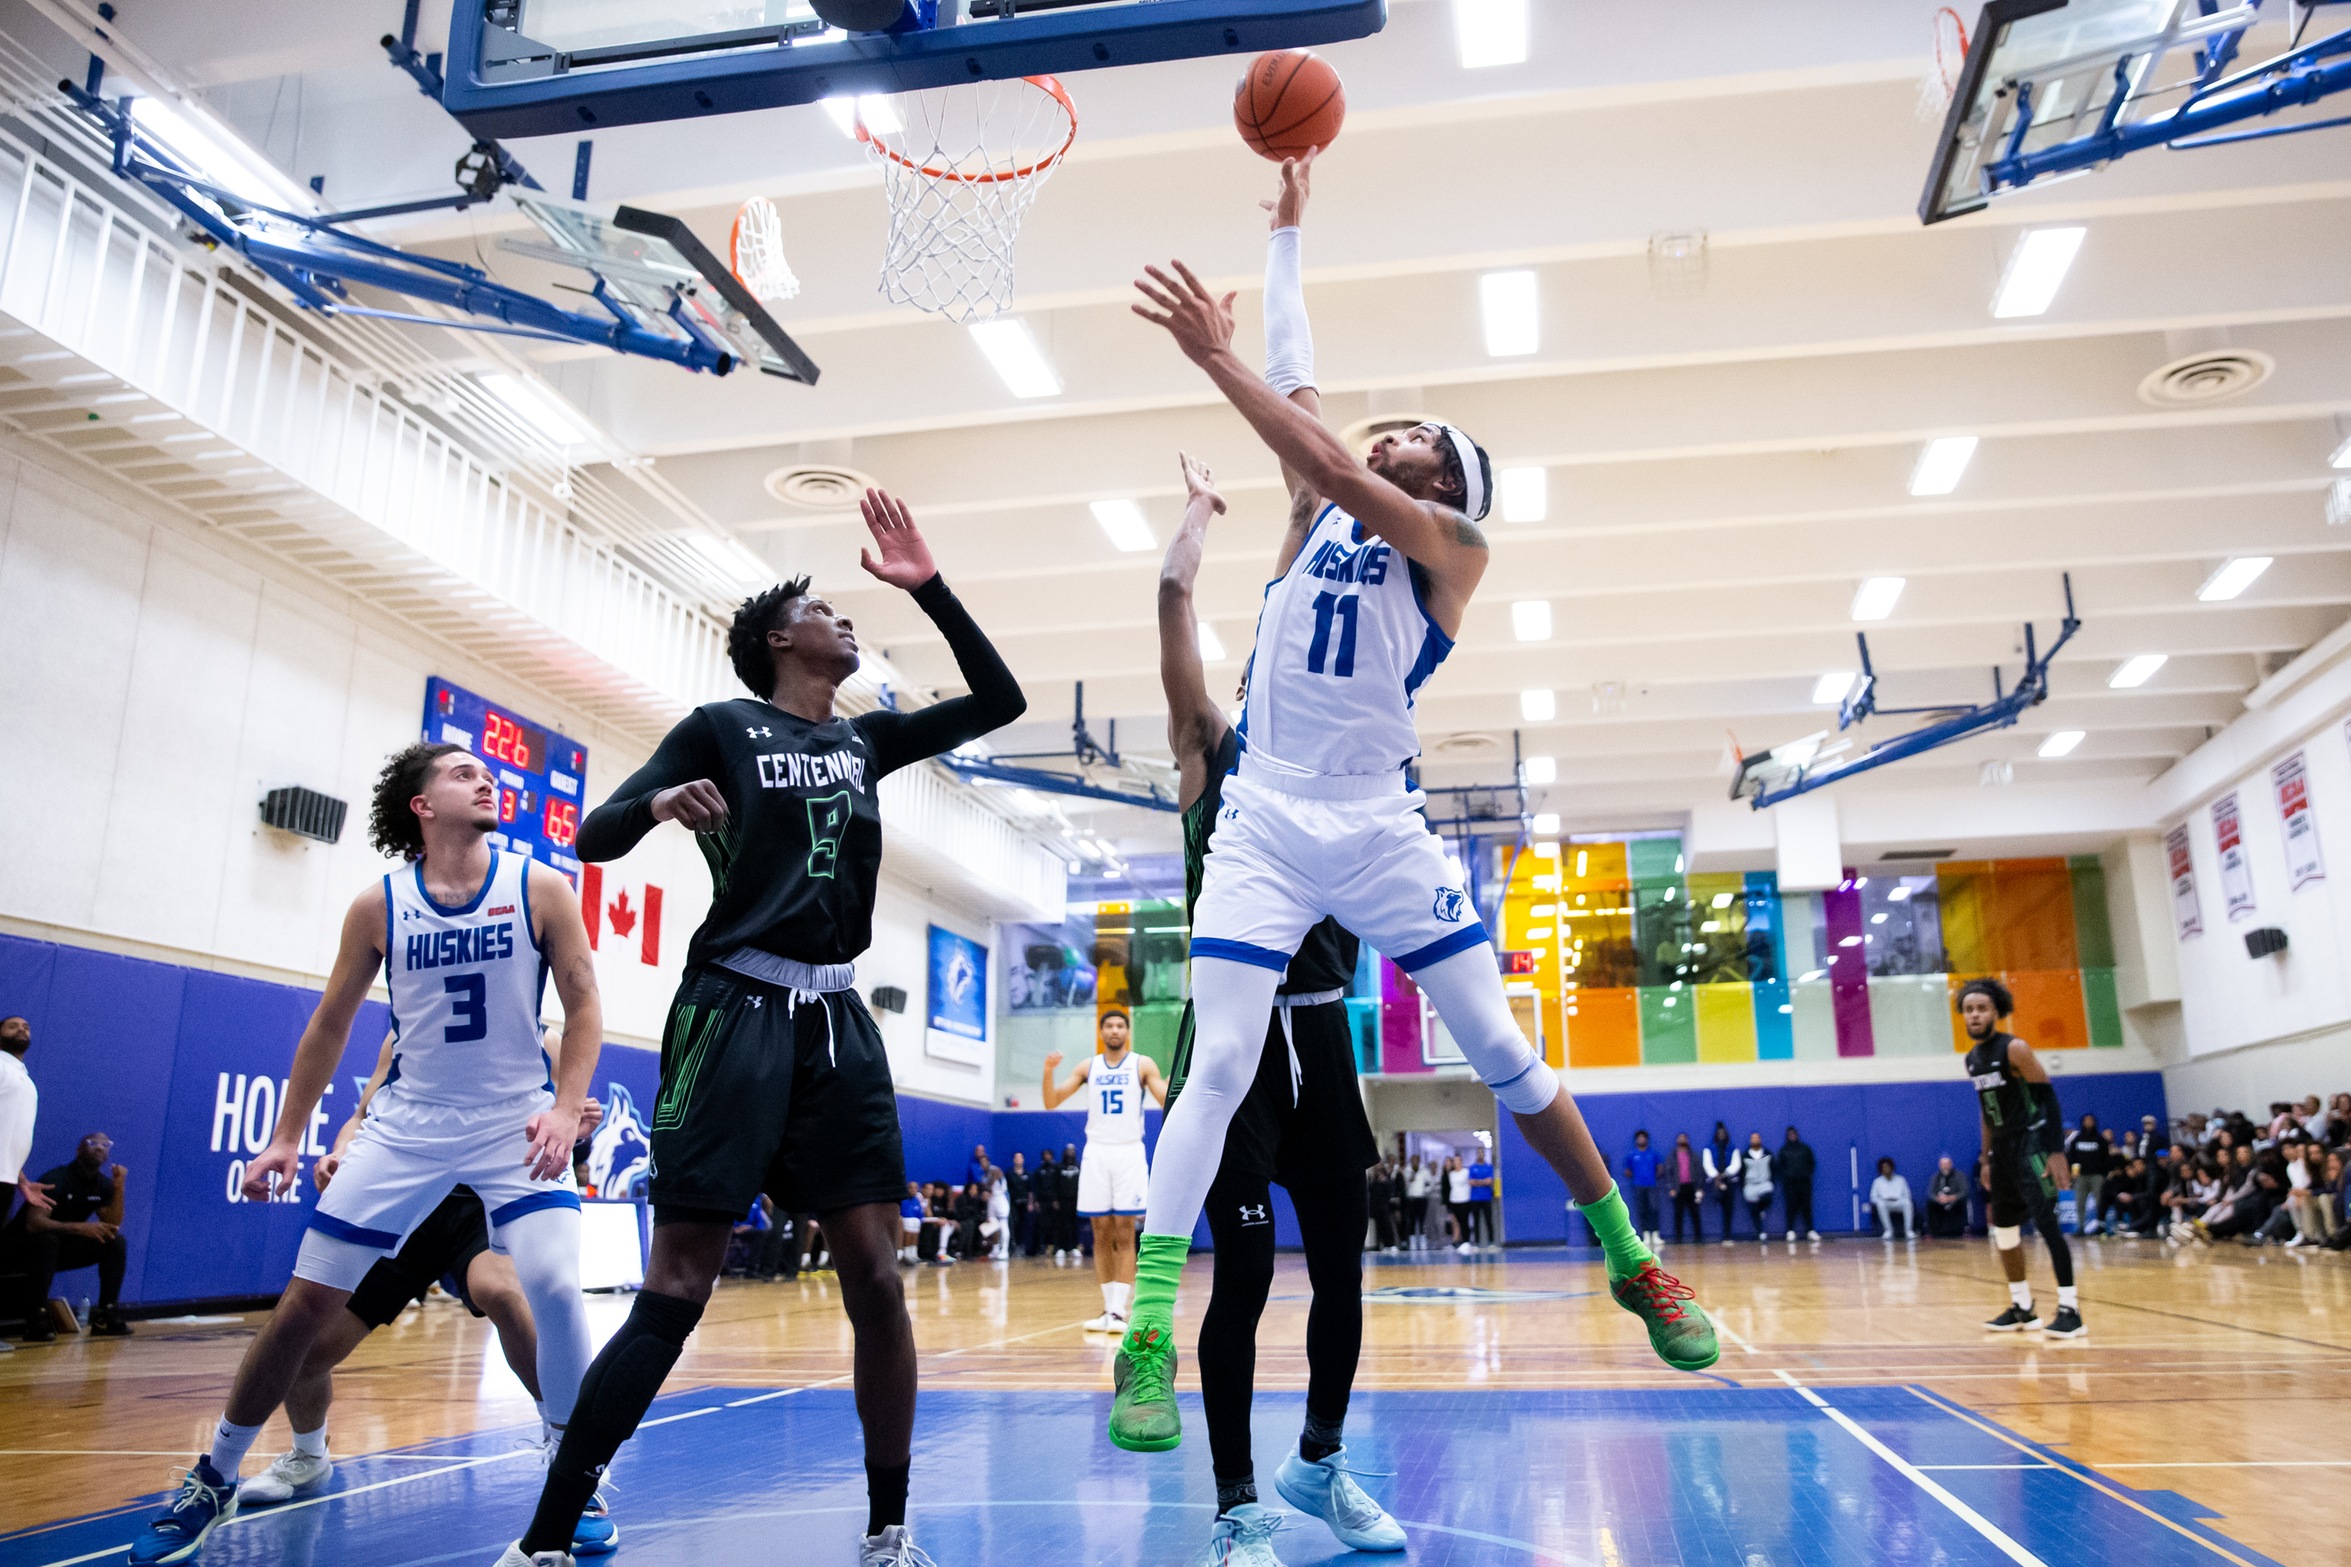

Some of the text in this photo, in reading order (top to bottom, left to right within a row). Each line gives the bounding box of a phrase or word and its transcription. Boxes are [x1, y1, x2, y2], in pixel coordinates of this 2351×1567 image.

[1308, 590, 1359, 677] 11
[756, 750, 866, 795] CENTENNAL
[500, 788, 516, 823] 3
[543, 798, 577, 846] 65
[806, 790, 853, 879] 9
[406, 922, 513, 971] HUSKIES
[444, 972, 487, 1043] 3
[210, 1072, 334, 1156] HOE
[1101, 1090, 1123, 1114] 15
[1983, 1090, 2004, 1126] 4
